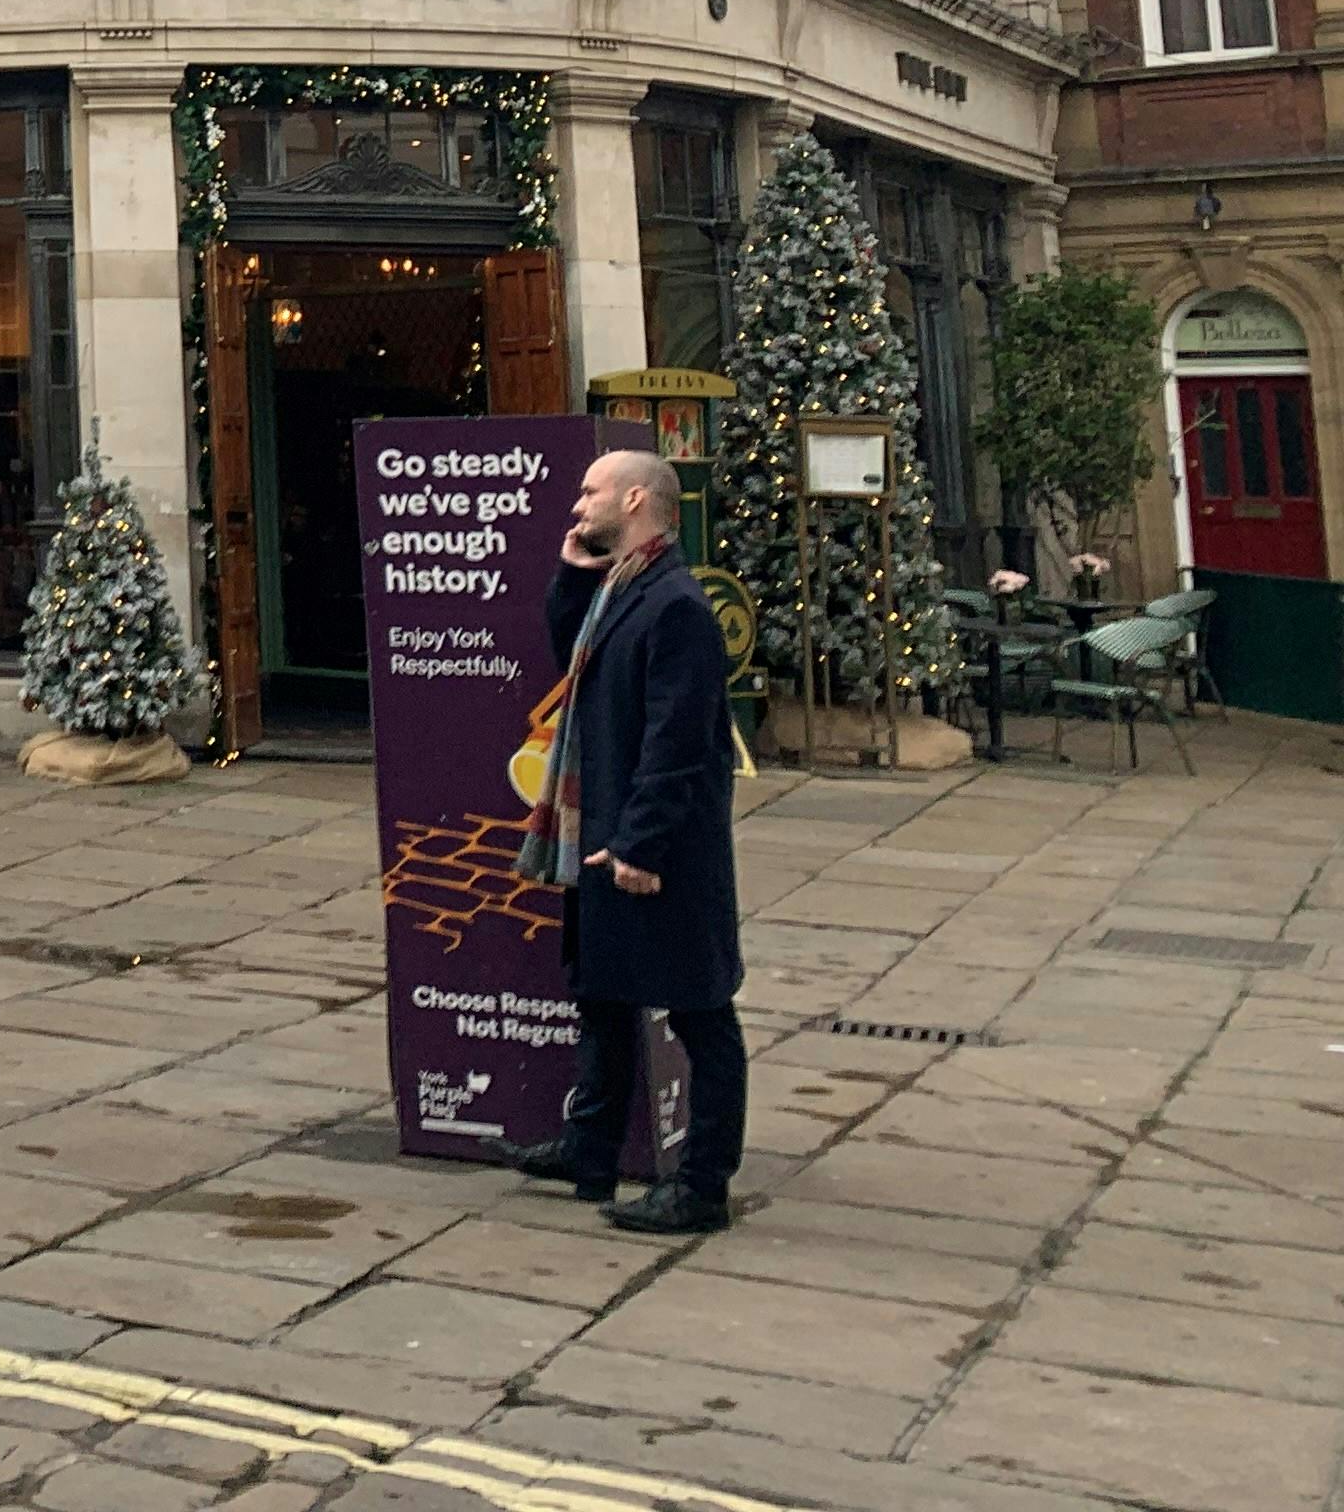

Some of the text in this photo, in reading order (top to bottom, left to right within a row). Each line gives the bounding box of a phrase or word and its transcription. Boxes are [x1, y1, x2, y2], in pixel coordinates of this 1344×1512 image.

[376, 445, 551, 482] Go steady,
[378, 484, 532, 523] we've got
[381, 525, 507, 562] enough
[384, 563, 508, 601] history.
[387, 626, 495, 652] Enjoy York
[412, 985, 582, 1021] Choose Respec
[456, 1014, 499, 1040] Not
